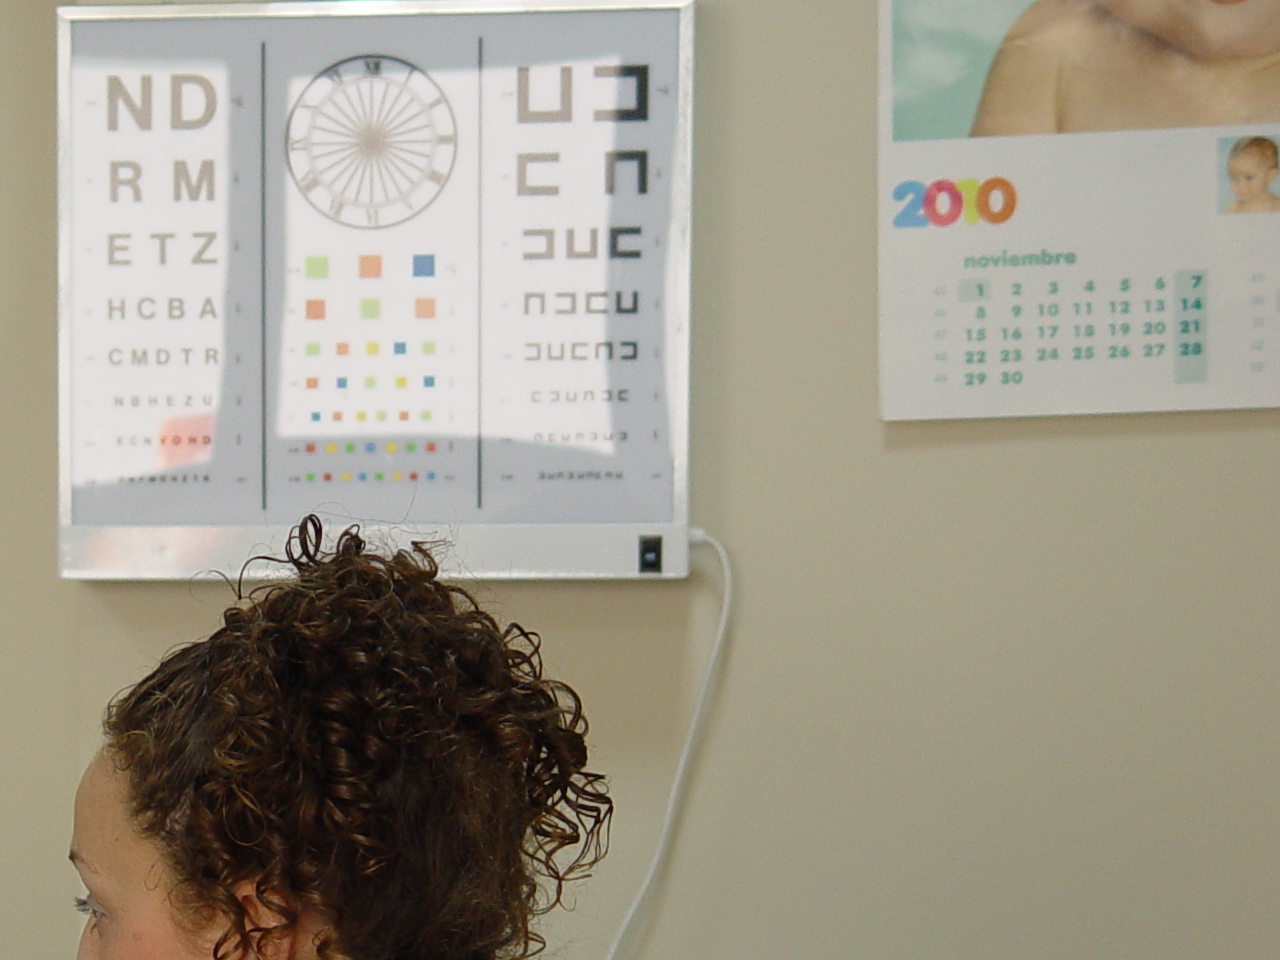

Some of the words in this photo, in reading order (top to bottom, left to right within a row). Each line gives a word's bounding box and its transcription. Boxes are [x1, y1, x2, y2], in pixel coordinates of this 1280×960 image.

[892, 176, 1017, 229] 2010
[964, 249, 1077, 269] noviembre
[976, 284, 984, 297] 1
[1011, 282, 1022, 296] 2
[1048, 281, 1059, 294] 3
[1084, 280, 1095, 292] 4
[1120, 278, 1130, 292] 5
[1155, 277, 1165, 290] 6
[1191, 275, 1203, 288] 7
[976, 306, 986, 320] 8
[1012, 304, 1022, 318] 9
[1038, 304, 1059, 317] 10
[1073, 302, 1092, 315] 11
[1109, 301, 1130, 314] 12
[1144, 299, 1165, 312] 13
[1180, 298, 1203, 312] 14
[965, 328, 986, 341] 15
[1001, 327, 1022, 340] 16
[1037, 326, 1059, 339] 17
[1073, 324, 1095, 338] 18
[1108, 323, 1131, 336] 19
[1143, 322, 1166, 335] 20
[1179, 320, 1200, 334] 21
[964, 350, 986, 364] 22
[1000, 350, 1022, 363] 23
[1037, 348, 1059, 361] 24
[1072, 347, 1095, 360] 25
[1108, 345, 1131, 359] 26
[1143, 344, 1166, 358] 27
[1179, 342, 1203, 356] 28
[964, 373, 987, 386] 29
[1001, 371, 1023, 385] 30
